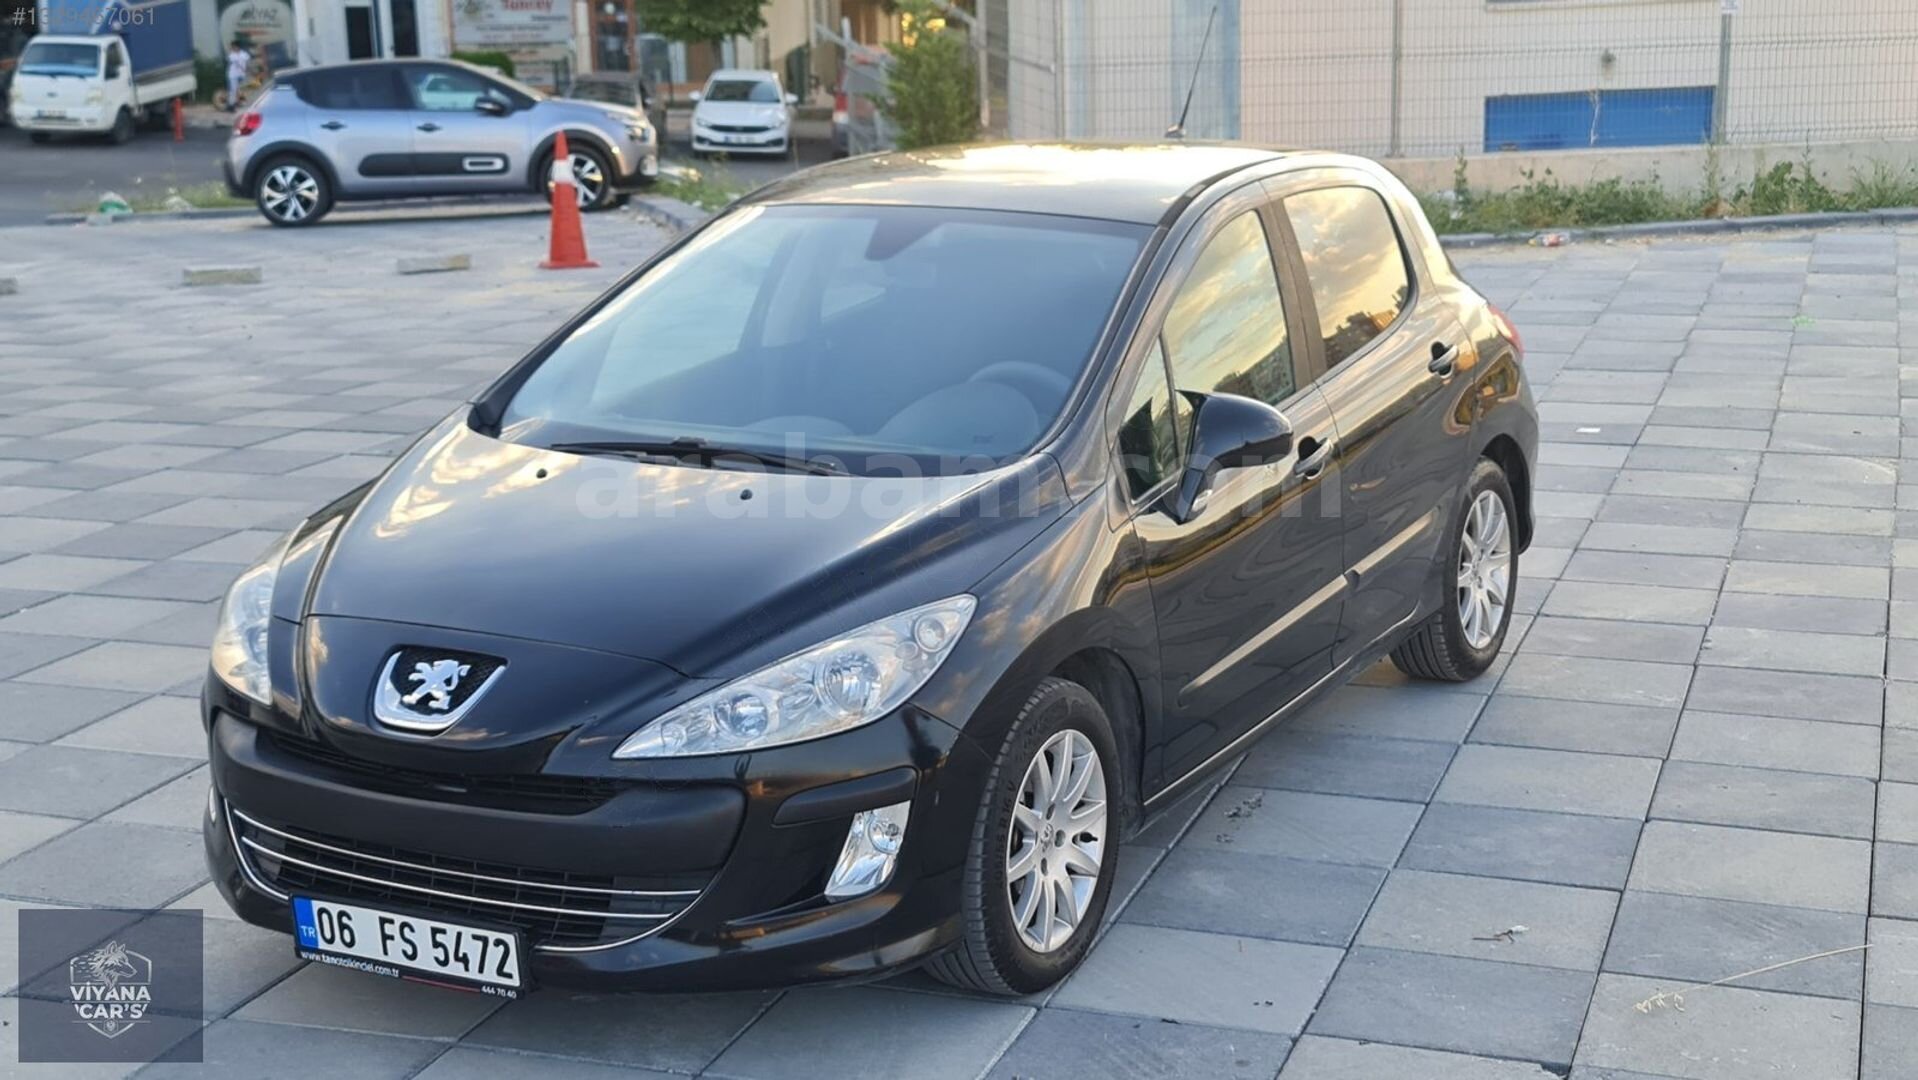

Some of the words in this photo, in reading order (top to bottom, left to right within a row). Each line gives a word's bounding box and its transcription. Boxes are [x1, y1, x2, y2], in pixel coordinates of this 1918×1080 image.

[301, 925, 317, 938] TR
[316, 906, 356, 948] 06
[378, 916, 418, 961] FS
[430, 926, 513, 979] 5472
